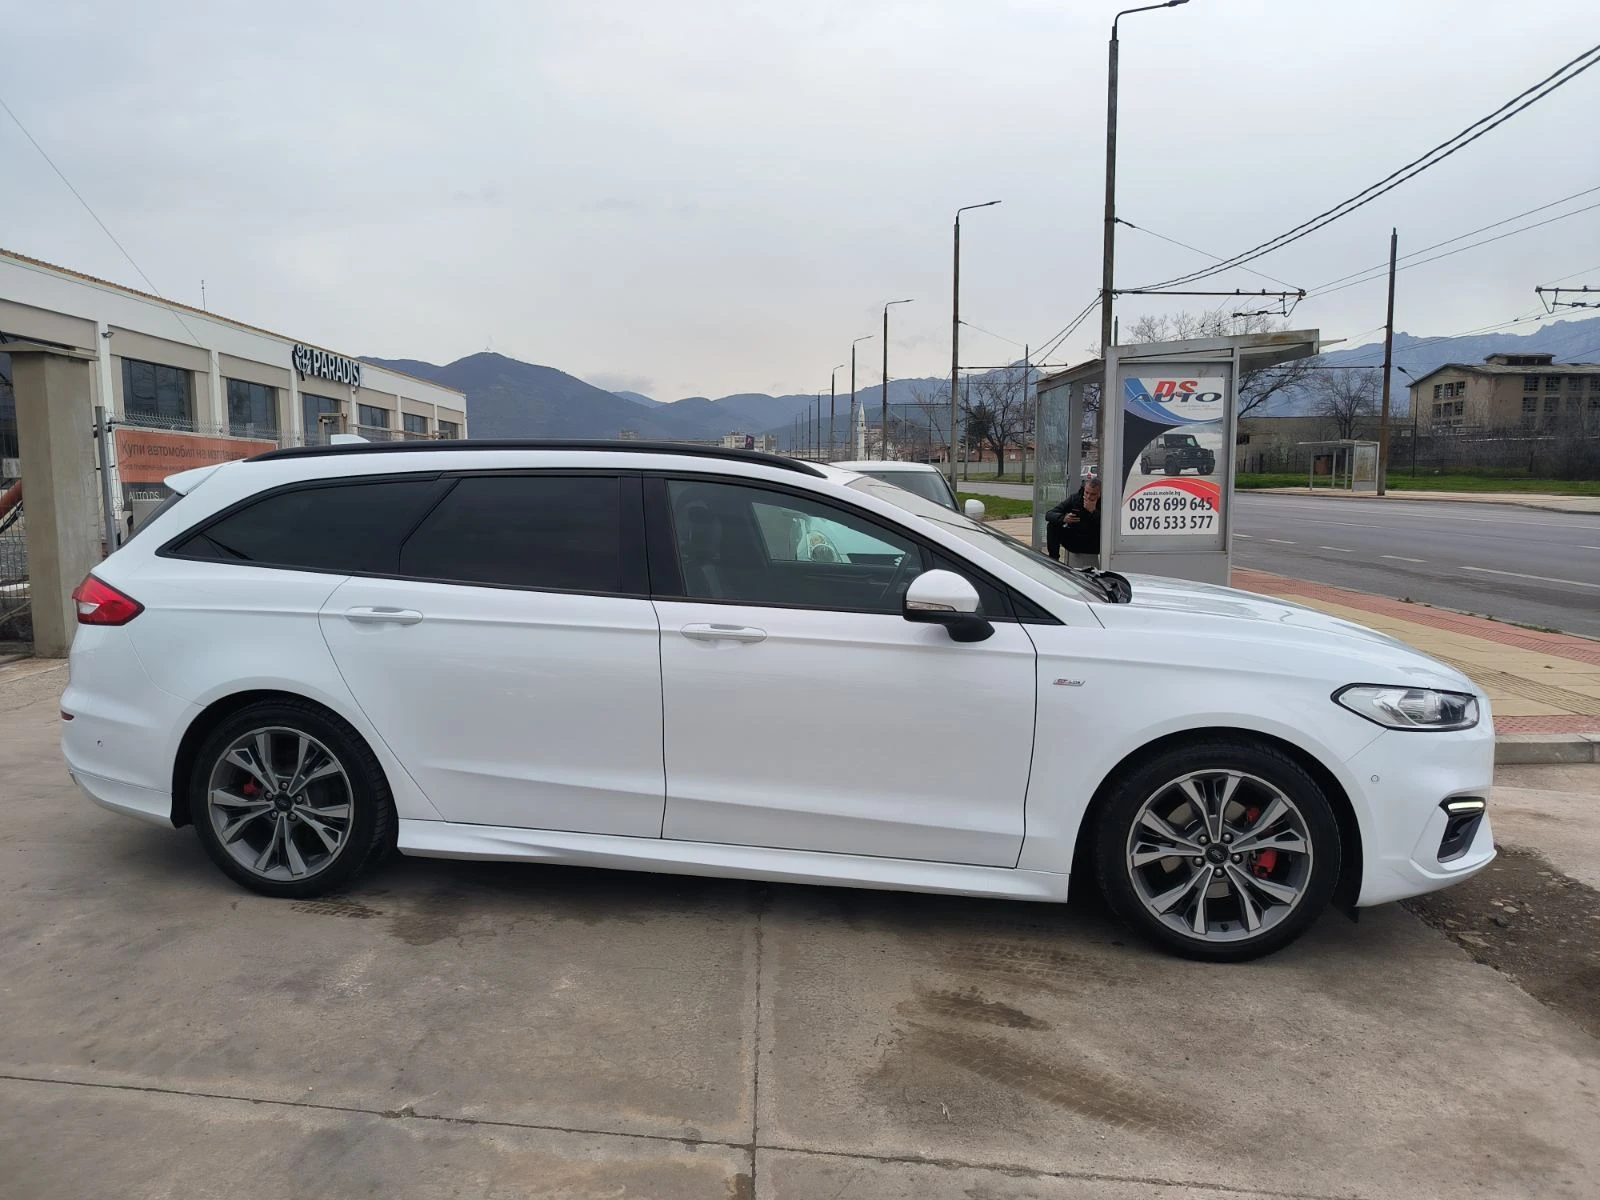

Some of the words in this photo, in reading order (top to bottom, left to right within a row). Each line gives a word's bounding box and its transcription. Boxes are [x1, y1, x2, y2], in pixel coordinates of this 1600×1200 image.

[1154, 380, 1198, 398] DS
[1128, 392, 1222, 403] AUTO
[122, 440, 145, 458] Купи
[147, 445, 194, 458] автомобил
[1129, 497, 1160, 512] 0878
[1163, 497, 1187, 511] 699
[1190, 497, 1213, 511] 645
[1129, 516, 1160, 530] 0876
[1163, 515, 1186, 530] 533
[1190, 515, 1213, 529] 577
